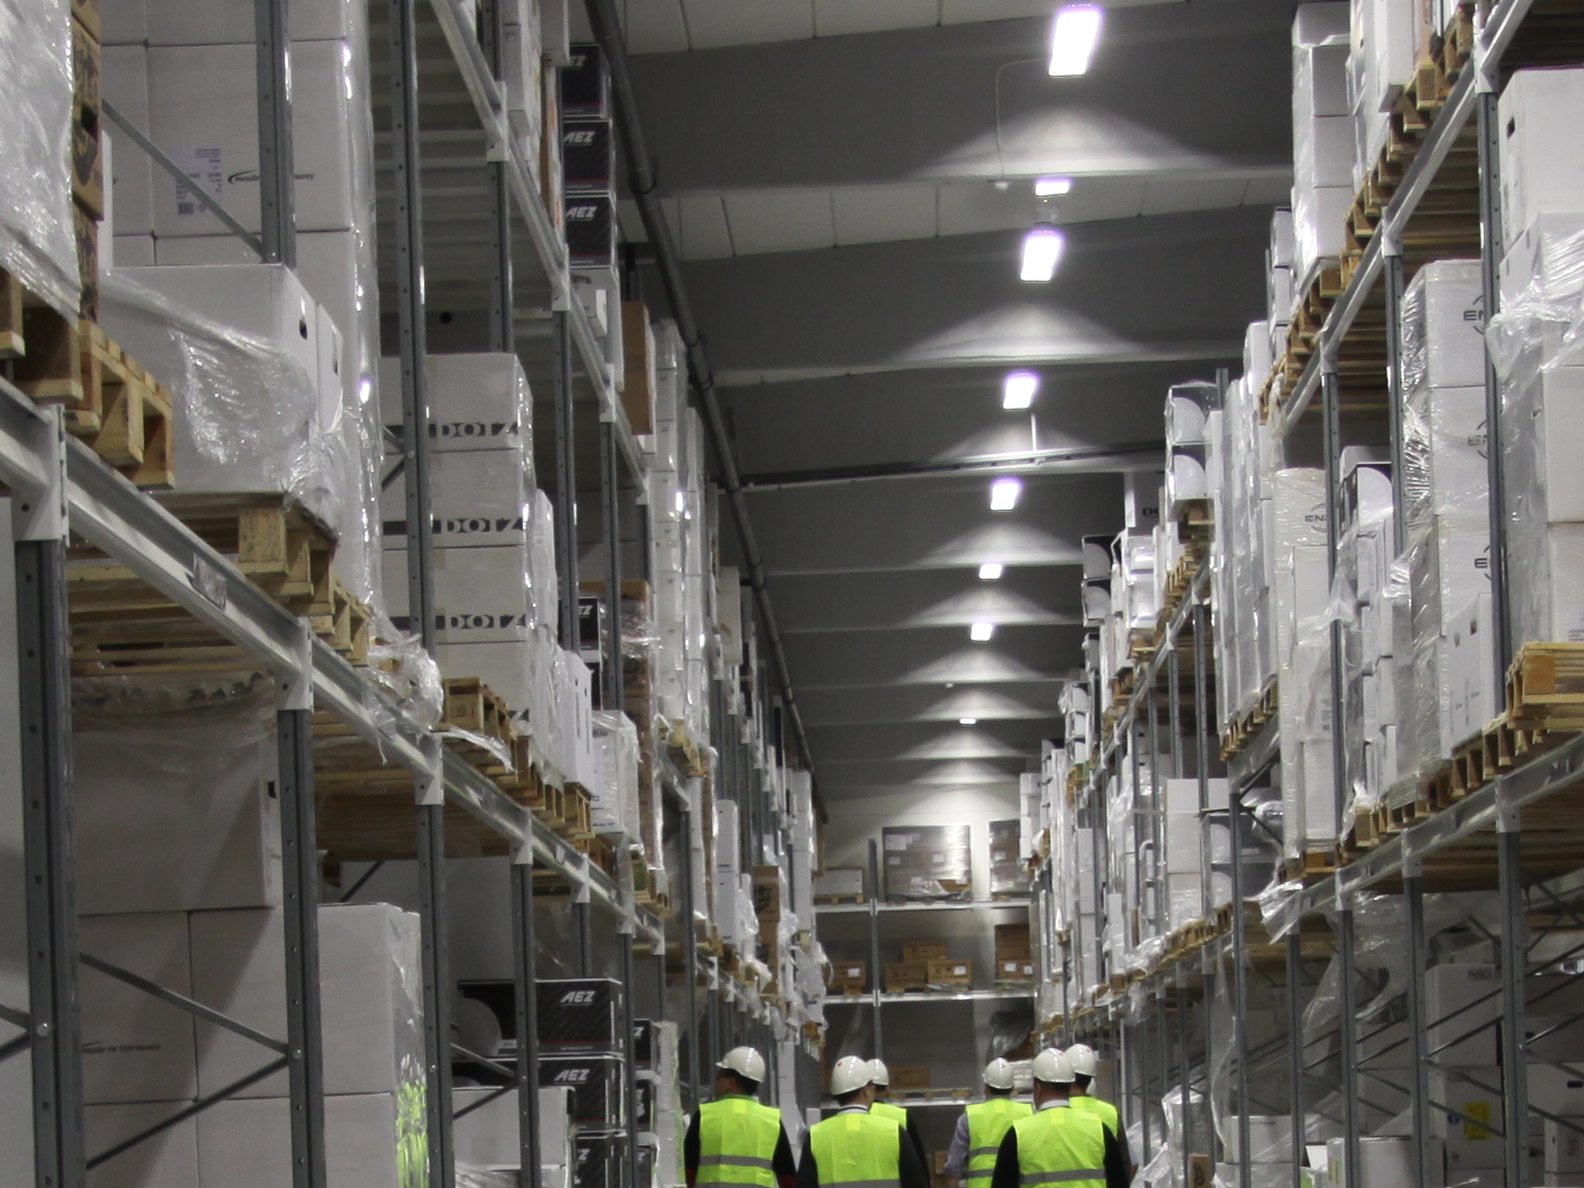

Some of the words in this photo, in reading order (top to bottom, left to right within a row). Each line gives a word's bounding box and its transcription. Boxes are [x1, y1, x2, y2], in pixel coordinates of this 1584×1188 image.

[563, 131, 595, 143] AEZ
[565, 206, 597, 218] AEZ
[436, 422, 518, 438] DOTZ
[440, 518, 523, 534] DOTZ
[444, 614, 526, 630] DOTZ
[560, 990, 596, 1003] AEZ
[119, 1044, 161, 1054] Germany
[553, 1068, 590, 1082] AEZ
